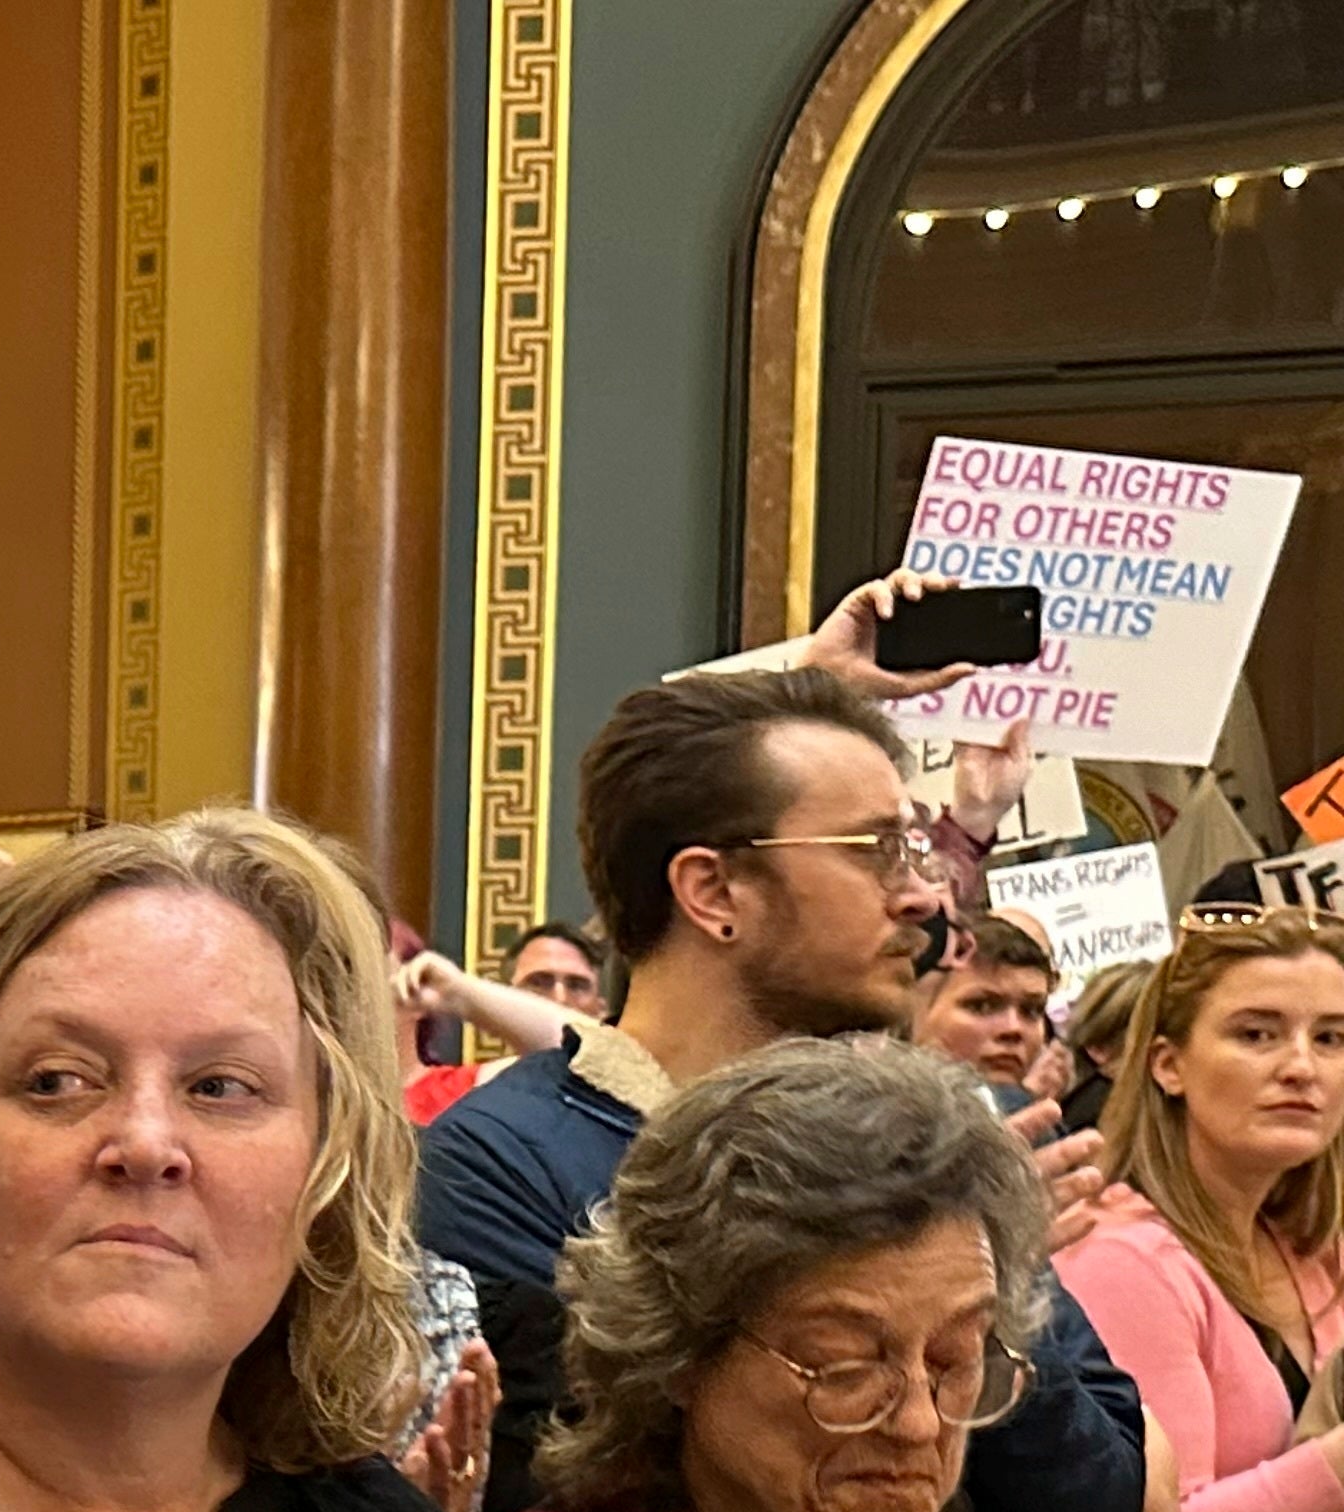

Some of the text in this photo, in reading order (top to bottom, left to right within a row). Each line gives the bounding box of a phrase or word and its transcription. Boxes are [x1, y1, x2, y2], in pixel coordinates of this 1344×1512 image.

[933, 445, 1230, 509] EQUAL RIGHTS
[917, 497, 1176, 551] FOR OTHERS
[908, 539, 1231, 601] DOES NOT MEAN
[964, 682, 1049, 719] NOT
[1053, 689, 1118, 729] PIE
[990, 852, 1153, 902] TRANS RIGHTS
